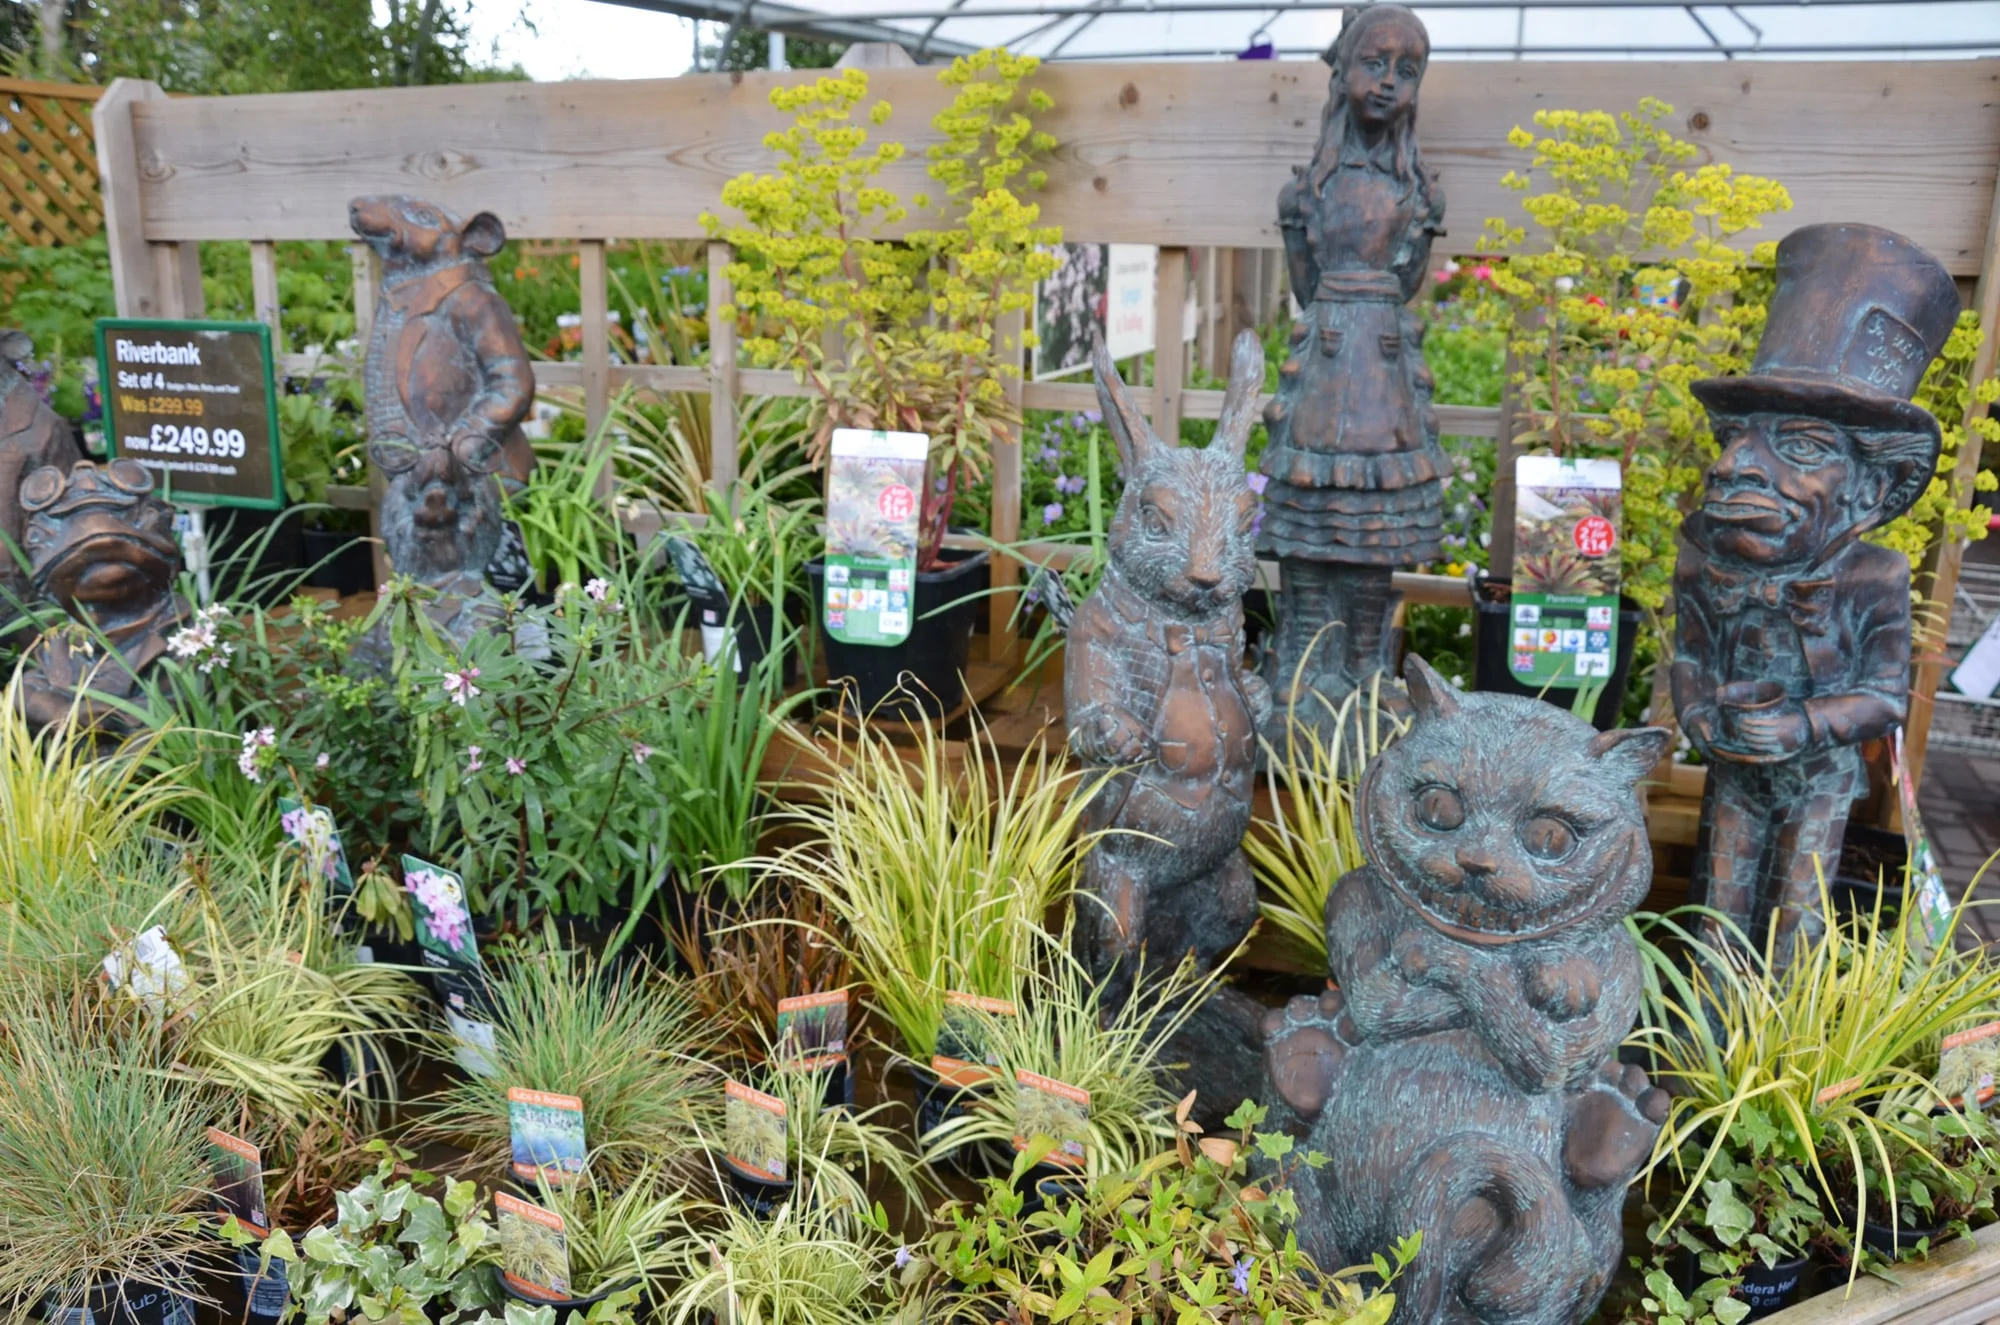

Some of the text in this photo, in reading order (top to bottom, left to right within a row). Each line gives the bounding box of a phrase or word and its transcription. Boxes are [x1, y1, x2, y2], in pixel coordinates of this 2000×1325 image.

[115, 338, 202, 366] Riverbank
[117, 370, 139, 389] Set
[139, 372, 153, 389] of
[154, 372, 165, 391] 4
[120, 394, 204, 417] Was £299.99
[124, 423, 246, 459] now £249.99
[1579, 526, 1609, 539] 2 for
[1581, 539, 1608, 552] £14
[1737, 1282, 1775, 1294] edera
[1751, 1296, 1781, 1306] 9 cm
